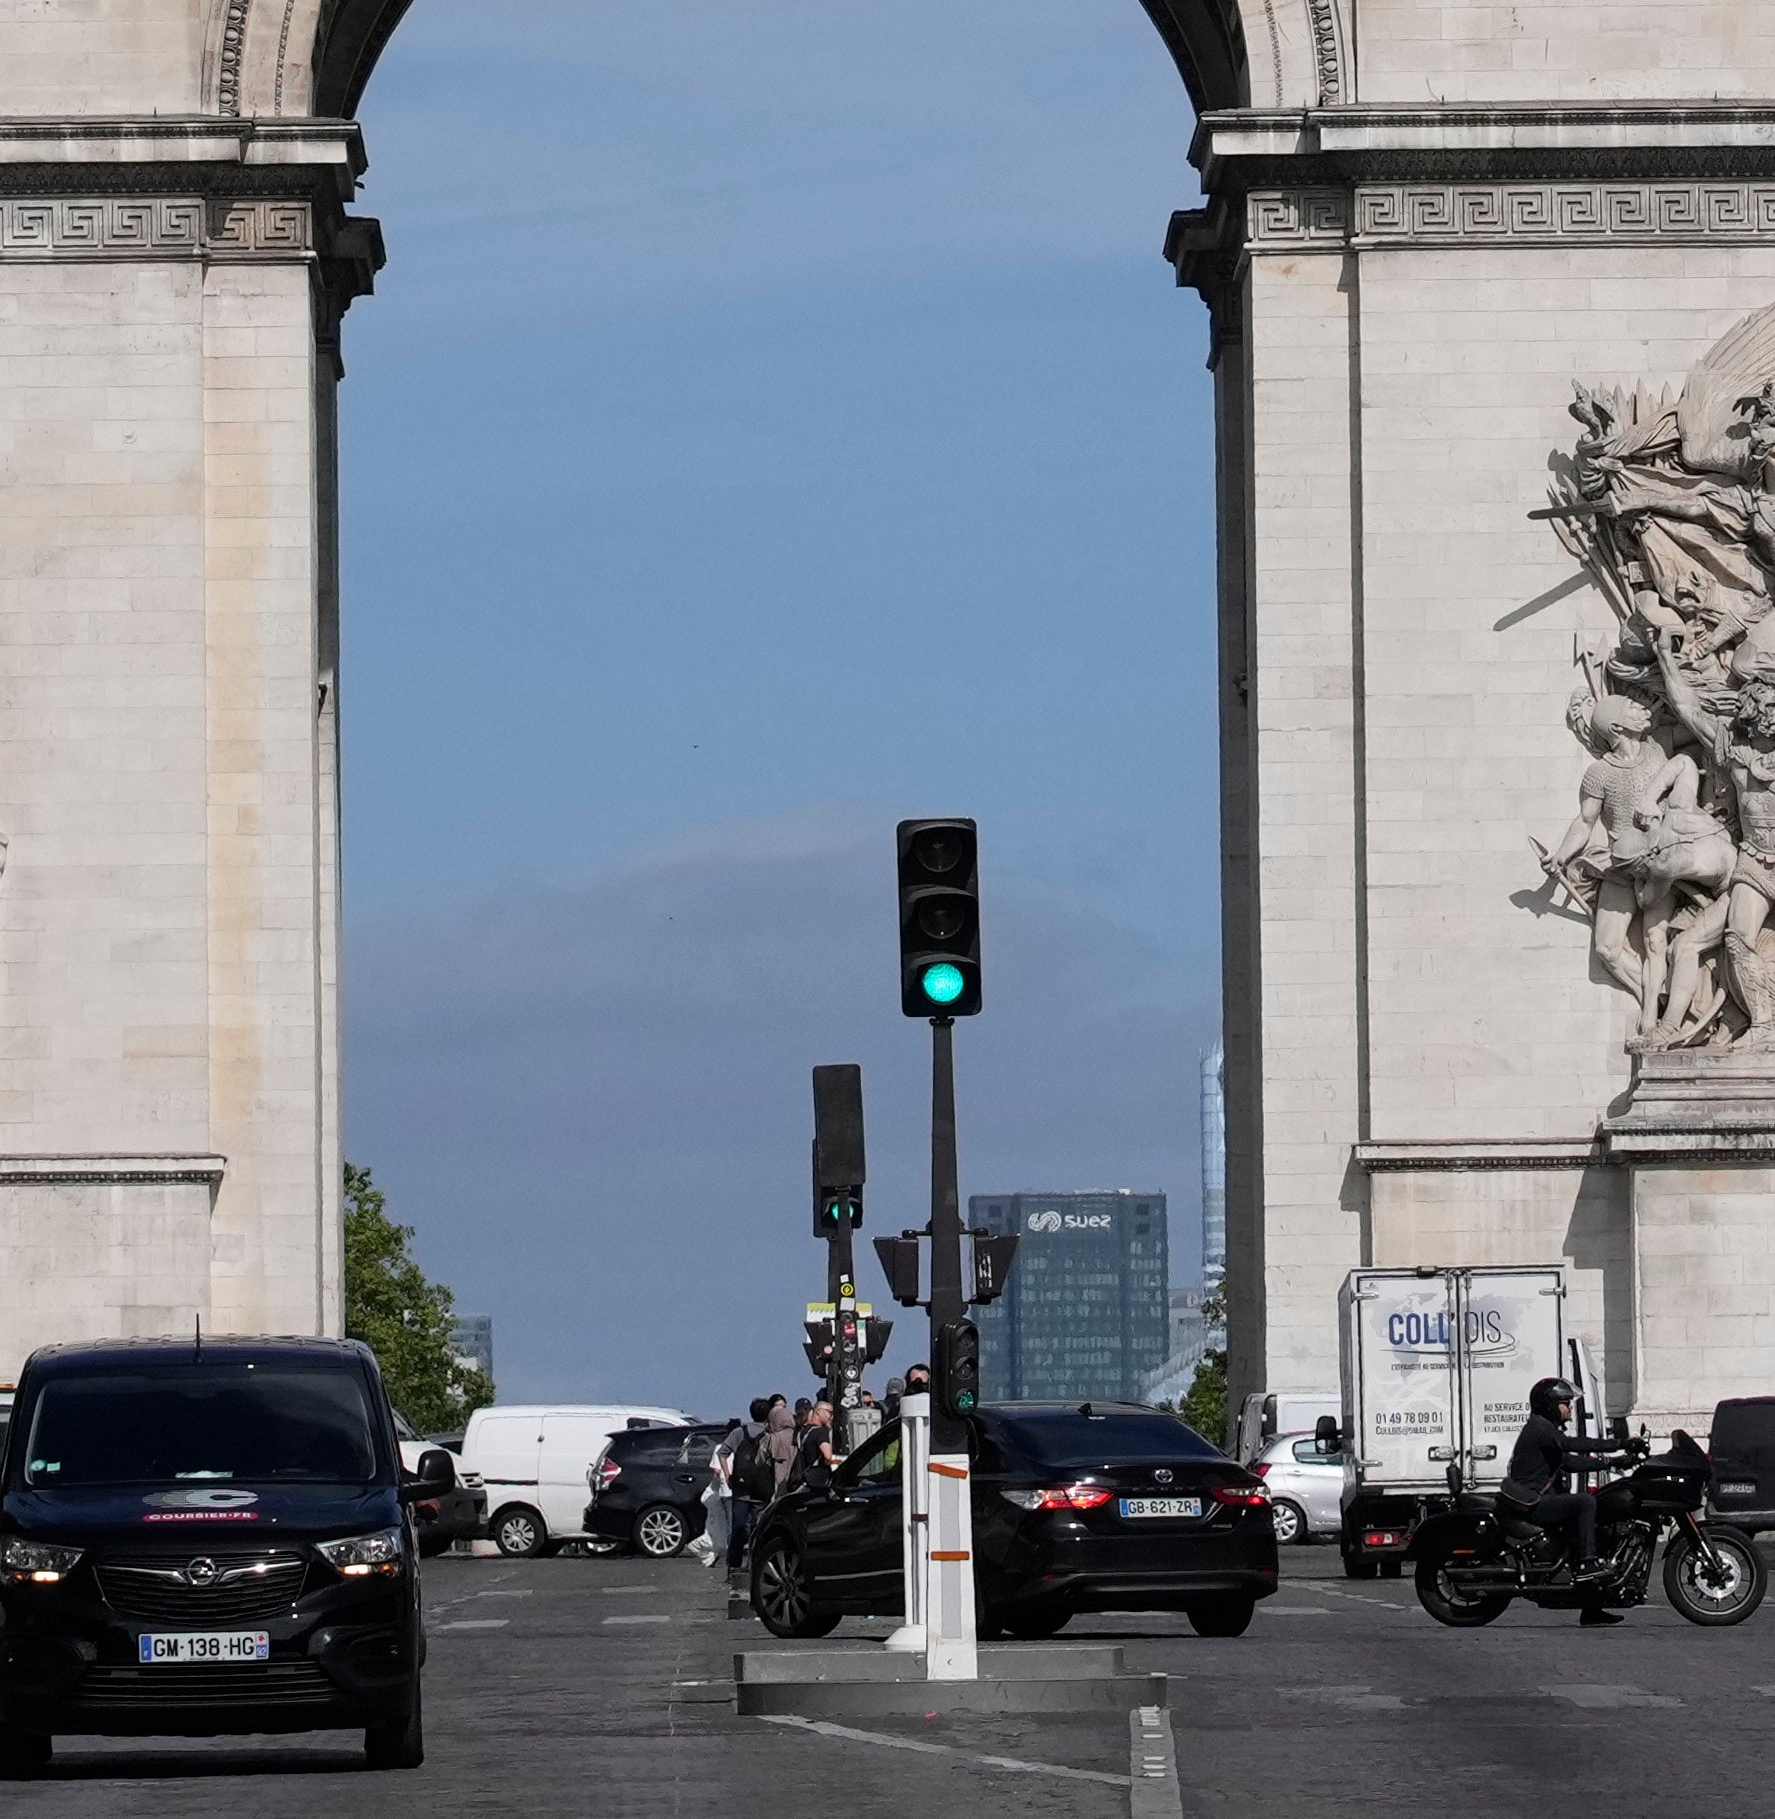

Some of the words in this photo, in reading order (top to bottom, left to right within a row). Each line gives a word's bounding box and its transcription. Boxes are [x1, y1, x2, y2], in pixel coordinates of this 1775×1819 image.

[1064, 1214, 1112, 1229] suez
[1375, 1413, 1387, 1424] 01
[1389, 1413, 1401, 1424] 49
[1404, 1413, 1415, 1423] 78
[1432, 1412, 1443, 1423] 01
[1128, 1501, 1193, 1514] GB-621-ZR
[153, 1637, 255, 1657] GM-138-HG
